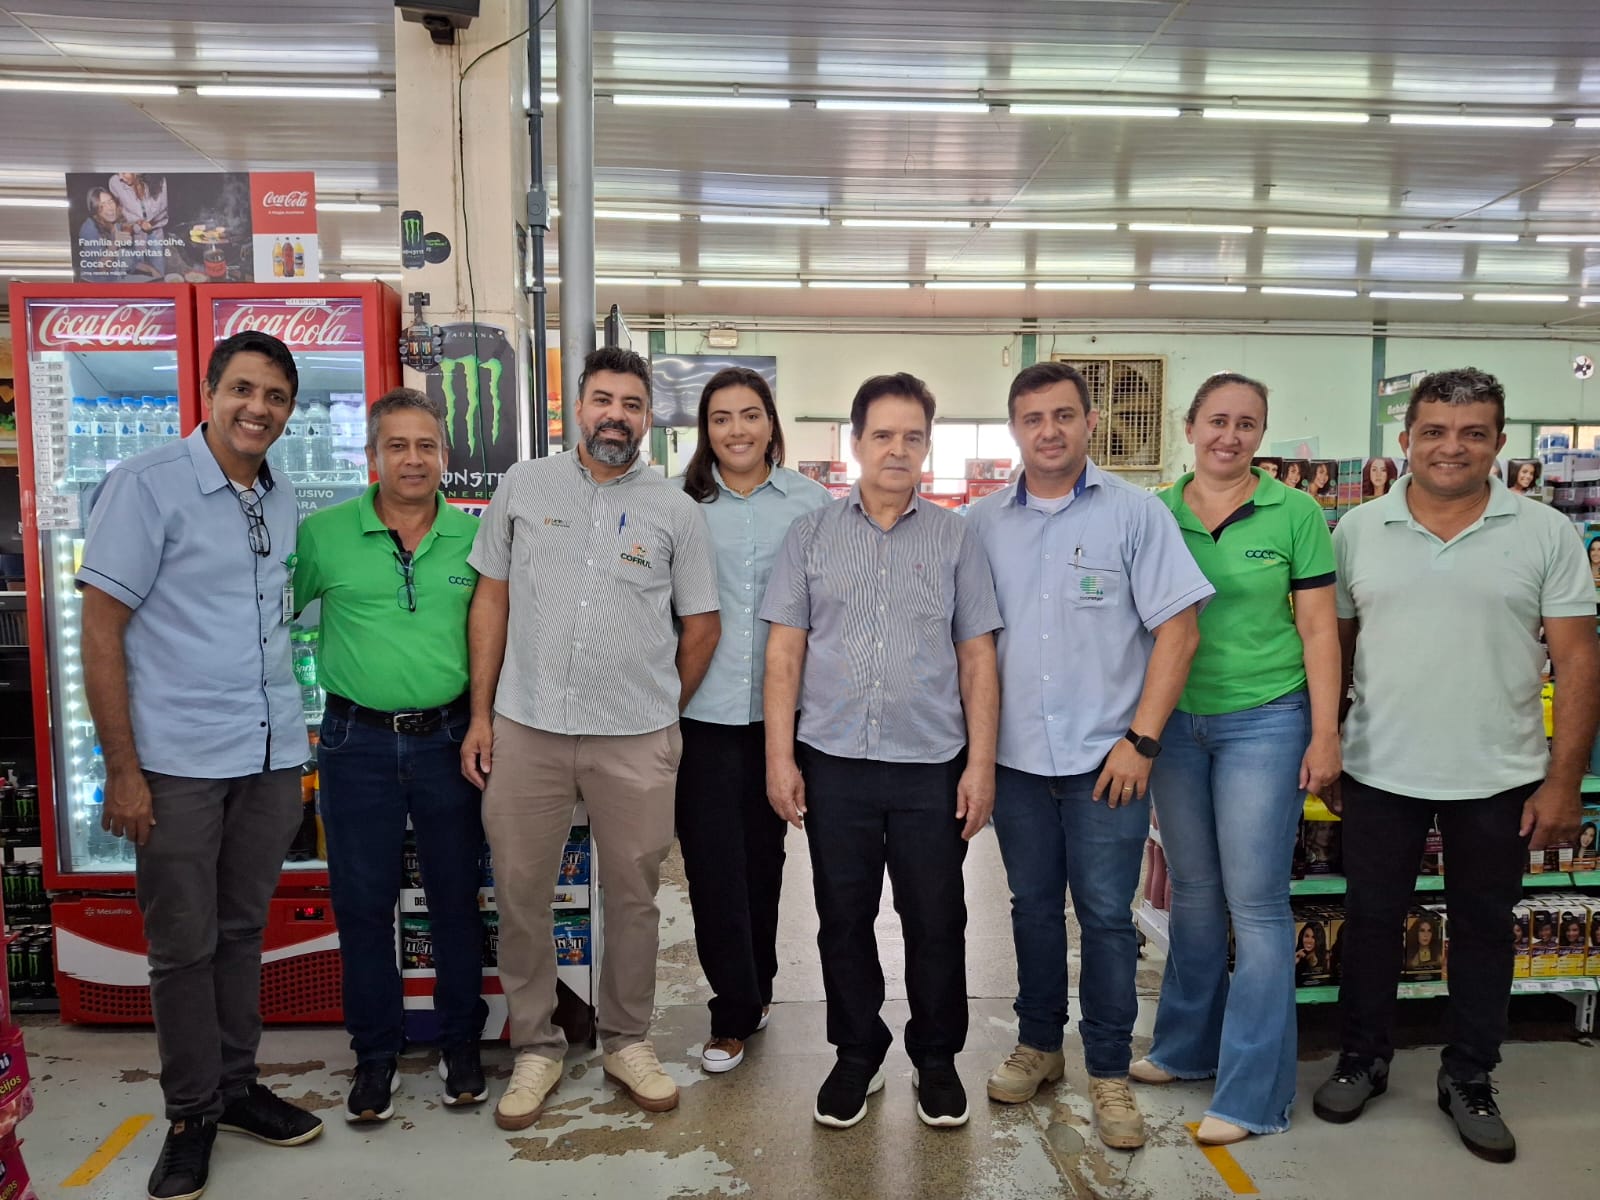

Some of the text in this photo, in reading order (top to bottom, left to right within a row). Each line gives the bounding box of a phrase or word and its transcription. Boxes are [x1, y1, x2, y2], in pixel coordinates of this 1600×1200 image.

[263, 191, 309, 207] Coca-Cola
[114, 239, 133, 248] que
[134, 239, 145, 247] se
[147, 238, 186, 247] escolhe,
[79, 248, 171, 257] comidas favoritas &
[39, 305, 167, 346] Coca-Cola
[223, 305, 352, 345] Coca-Cola
[0, 1075, 22, 1094] eijos
